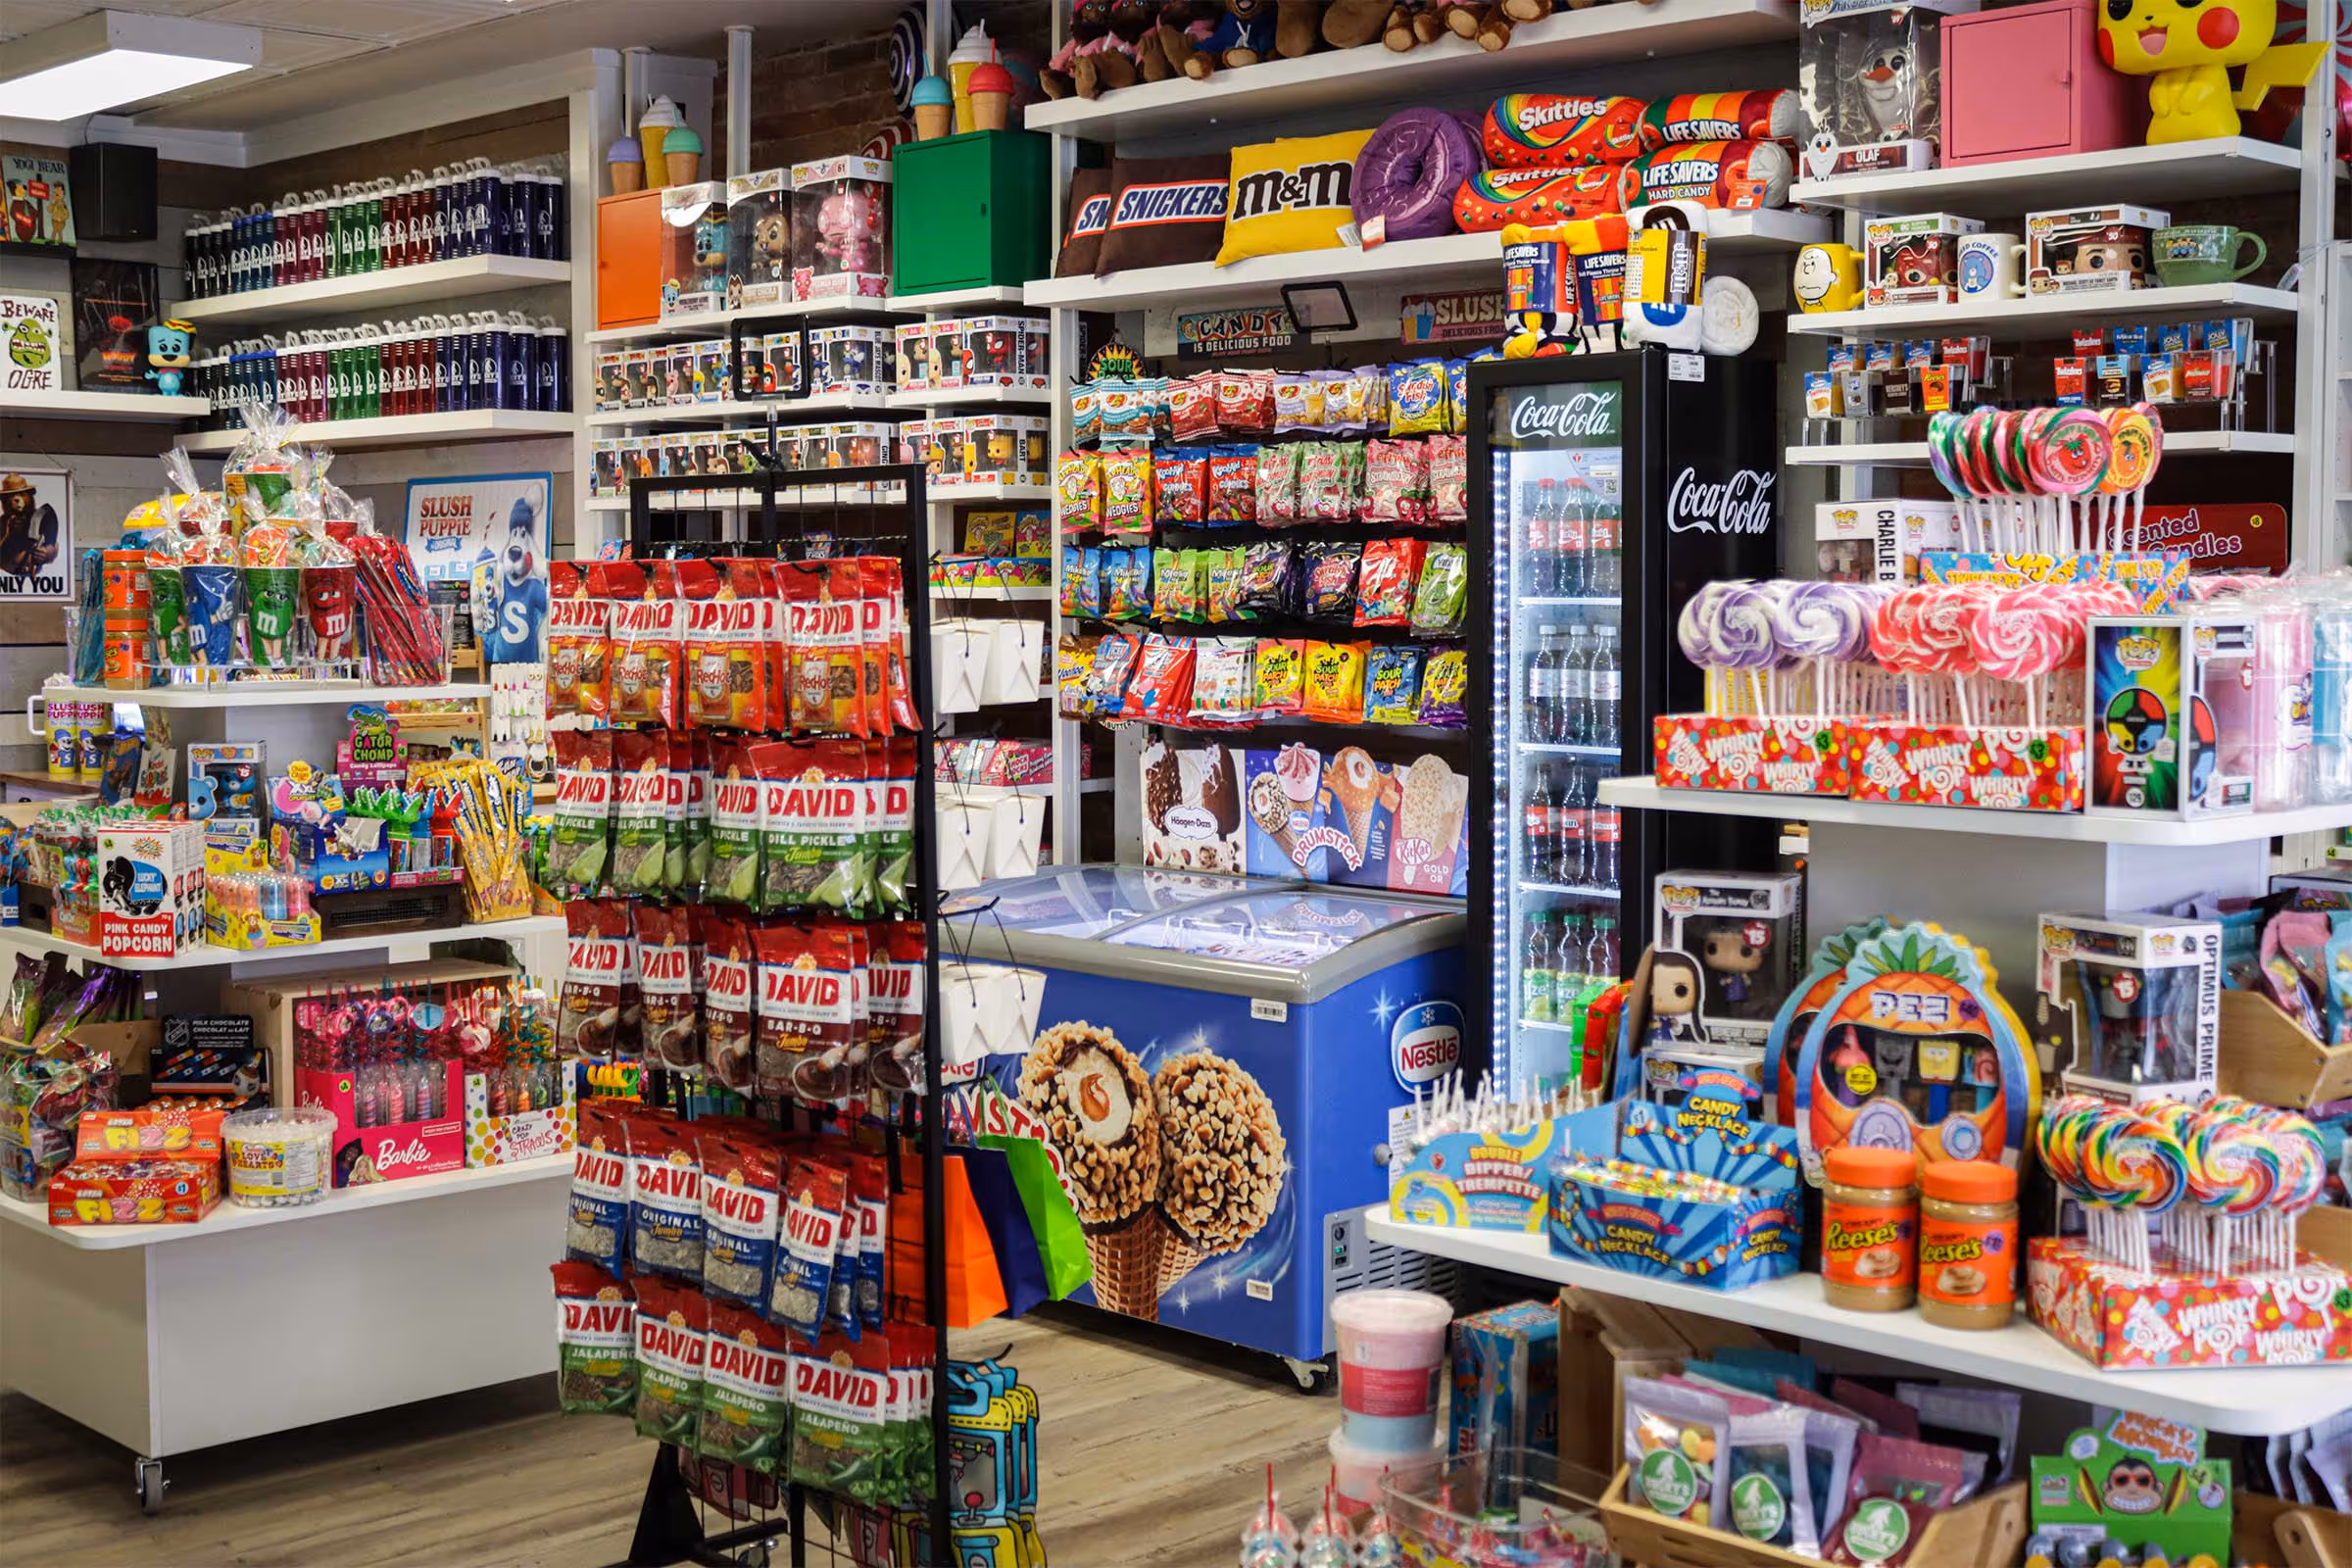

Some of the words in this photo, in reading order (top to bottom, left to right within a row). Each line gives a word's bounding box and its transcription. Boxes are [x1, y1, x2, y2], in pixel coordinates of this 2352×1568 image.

[1518, 99, 1608, 132] Skittles
[1690, 119, 1741, 140] SAVERS
[13, 157, 35, 171] YOGI
[37, 160, 66, 174] BEAR
[837, 163, 846, 172] 61
[1855, 149, 1880, 163] OLAF
[1491, 167, 1586, 189] Skittles
[1642, 164, 1670, 186] LIFE
[1670, 160, 1718, 184] SAVERS
[1118, 186, 1228, 222] SNICKERS
[1648, 189, 1675, 201] HARD
[1678, 186, 1711, 199] CANDY
[1972, 241, 1999, 259] COFFEE
[1585, 257, 1600, 269] LIFE
[1600, 255, 1626, 267] SAVERS
[0, 298, 56, 323] BEWARE
[1199, 312, 1285, 337] CANDY
[1442, 325, 1483, 337] DELICIOUS
[2207, 329, 2227, 341] JOLLY
[1017, 320, 1026, 375] SPIDER-MAN
[1194, 343, 1202, 353] IS
[1205, 337, 1252, 352] DELICIOUS
[1256, 335, 1292, 348] FOOD
[2162, 334, 2181, 346] JOLLY
[1100, 359, 1134, 374] SOUR
[8, 369, 54, 389] OGRE
[1510, 392, 1616, 439] Coca-Cola
[419, 496, 473, 518] SLUSH
[1668, 466, 1778, 534] Coca-Cola
[1877, 510, 1896, 567] CHARLIE
[30, 575, 64, 594] YOU
[501, 601, 527, 645] S
[615, 601, 674, 630] DAVID
[688, 601, 756, 630] DAVID
[791, 604, 853, 636] DAVID
[2118, 636, 2161, 660] POP!
[695, 667, 731, 684] RedHot
[800, 674, 833, 691] RedHot
[1376, 667, 1402, 680] SOUR
[1374, 679, 1401, 692] PATCH
[354, 735, 393, 750] GATOR
[1705, 732, 1765, 763] WHIRLY
[353, 748, 395, 762] CHOMP
[1905, 742, 1972, 776] WHIRLY
[1717, 754, 1759, 781] POP
[1764, 761, 1817, 784] WHIRLY
[1918, 764, 1967, 796] POP
[1970, 776, 2032, 799] WHIRLY
[768, 787, 855, 817] DAVID
[564, 818, 596, 830] PICKLE
[1170, 815, 1212, 829] Häagen-Dazs
[721, 831, 750, 843] PICKLE
[768, 834, 796, 845] DILL
[801, 834, 847, 847] PICKLE
[786, 845, 822, 865] Jumbo
[1397, 839, 1431, 863] KitKat
[136, 872, 157, 883] LUCKY
[1423, 863, 1449, 874] GOLD
[1431, 874, 1444, 884] OR
[134, 882, 163, 894] ELEPHANT
[104, 922, 129, 934] PINK
[132, 922, 168, 934] CANDY
[102, 936, 172, 953] POPCORN
[2200, 934, 2219, 1021] OPTIMUS
[775, 1032, 809, 1052] Jumbo
[2198, 1022, 2217, 1083] PRIME
[1688, 1096, 1742, 1119] CANDY
[104, 1126, 193, 1152] FIZZ
[376, 1138, 431, 1171] Barbie
[1469, 1146, 1521, 1163] DOUBLE
[637, 1164, 702, 1200] DAVI
[1455, 1178, 1542, 1200] TREMPETTE
[74, 1198, 167, 1223] FIZZ
[707, 1182, 765, 1224] DAVID
[642, 1208, 701, 1230] ORIGINAL
[1605, 1224, 1656, 1247] CANDY
[1826, 1221, 1898, 1249] Reese's
[2178, 1296, 2260, 1337] WHIRLY
[642, 1323, 706, 1365] DAVID
[2193, 1323, 2251, 1359] POP
[2255, 1329, 2327, 1355] WHIRLY
[710, 1340, 786, 1387] DAVID
[643, 1367, 689, 1393] JALAPEÑO
[796, 1367, 878, 1408] DAVID
[713, 1388, 766, 1413] JALAPEÑO
[799, 1411, 860, 1437] JALAPEÑO
